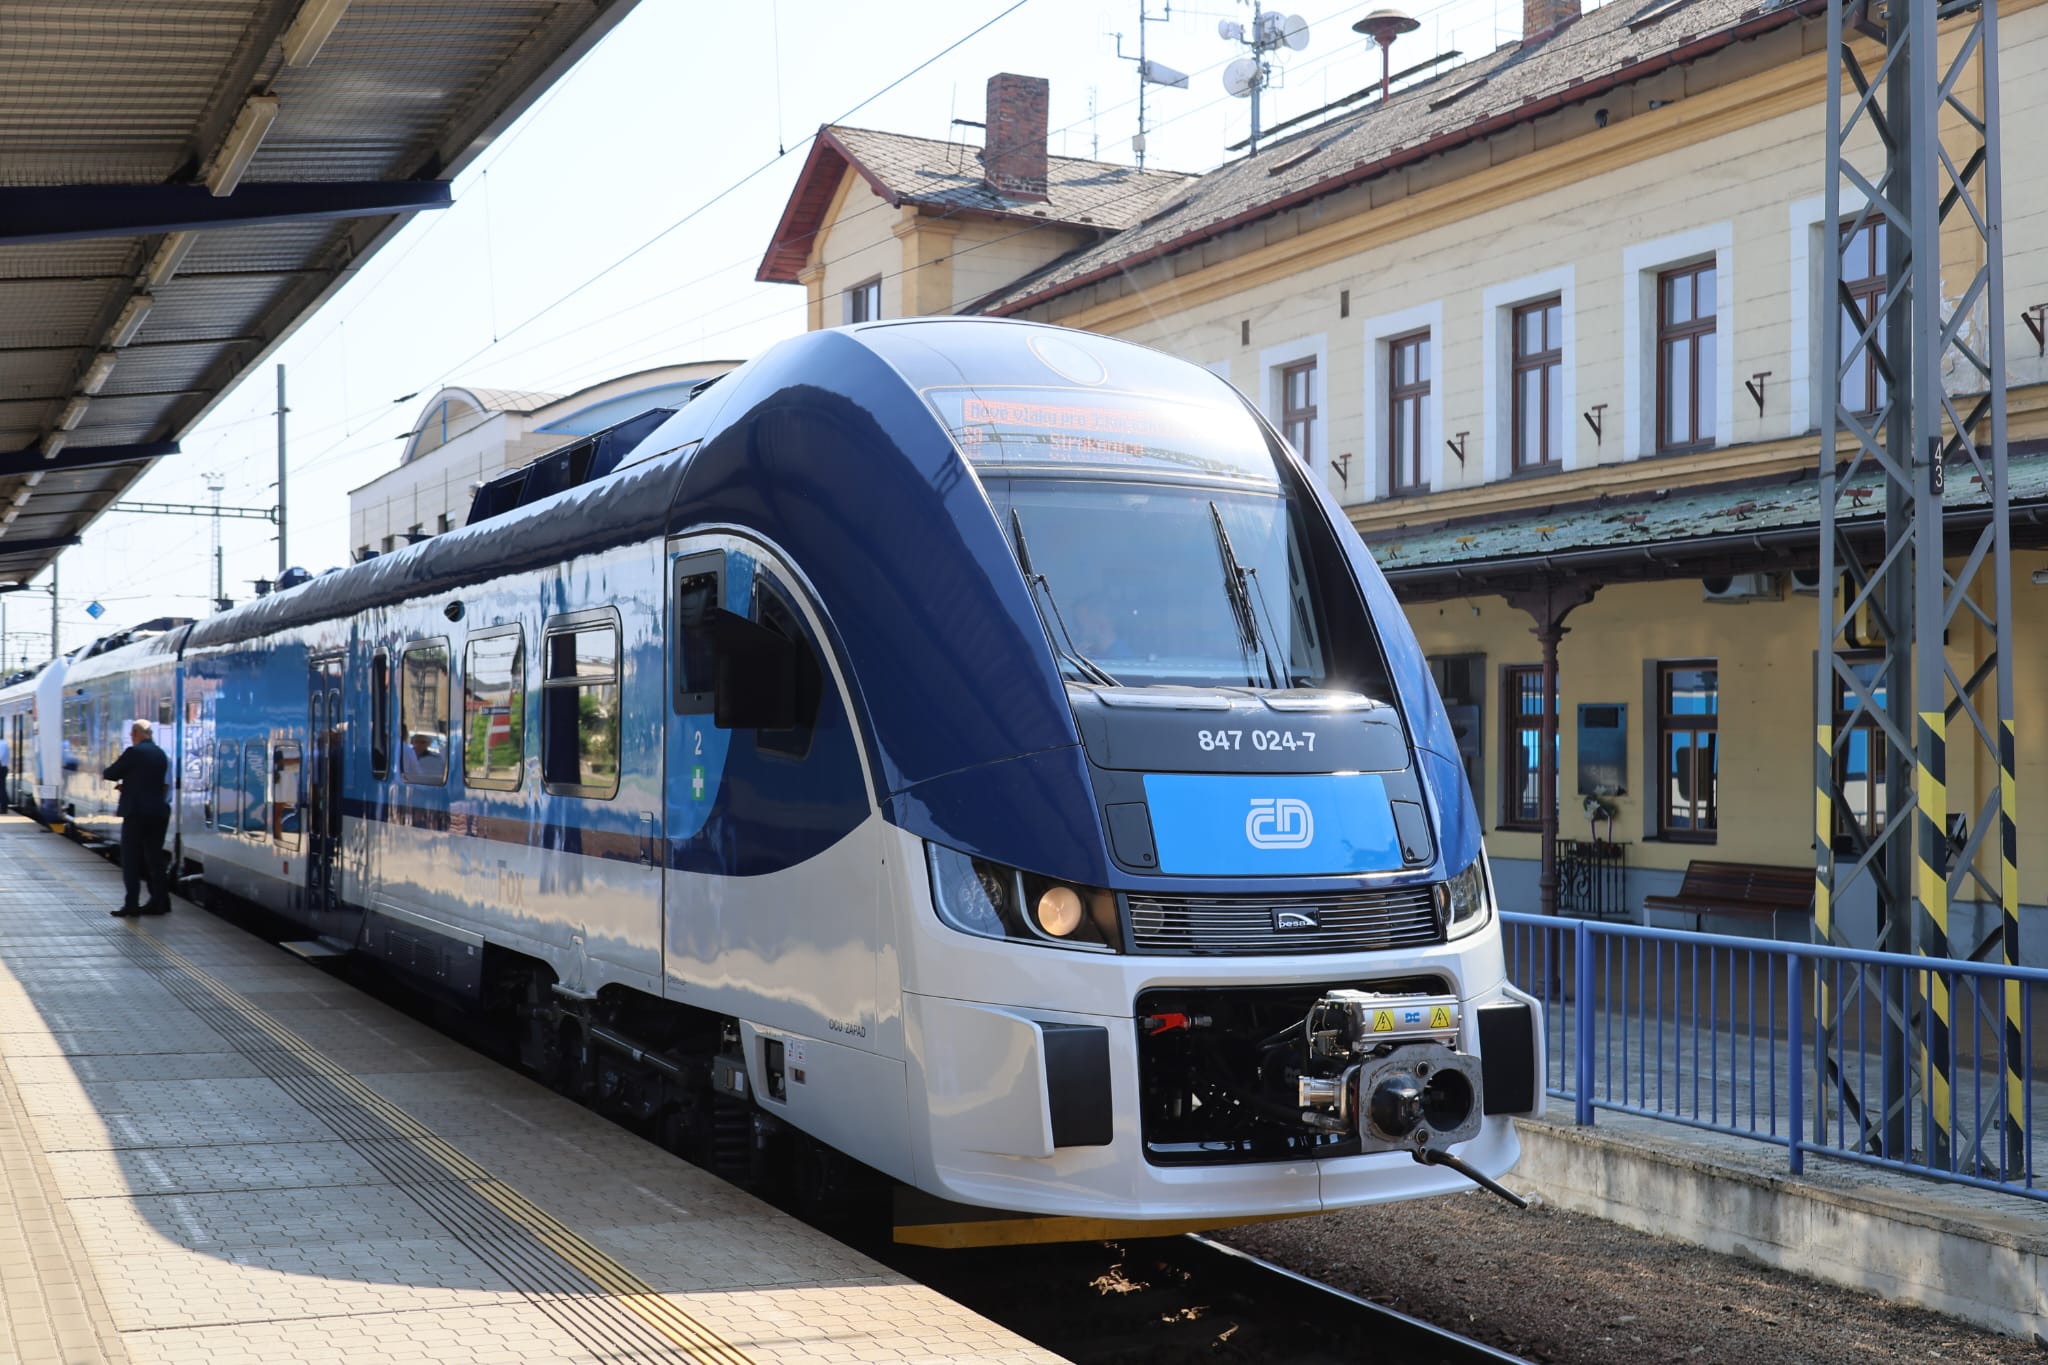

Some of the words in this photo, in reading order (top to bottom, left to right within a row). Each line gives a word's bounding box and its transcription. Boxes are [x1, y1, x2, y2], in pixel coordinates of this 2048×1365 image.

[695, 731, 702, 755] 2
[1198, 730, 1242, 751] 847
[1251, 730, 1316, 752] 024-7
